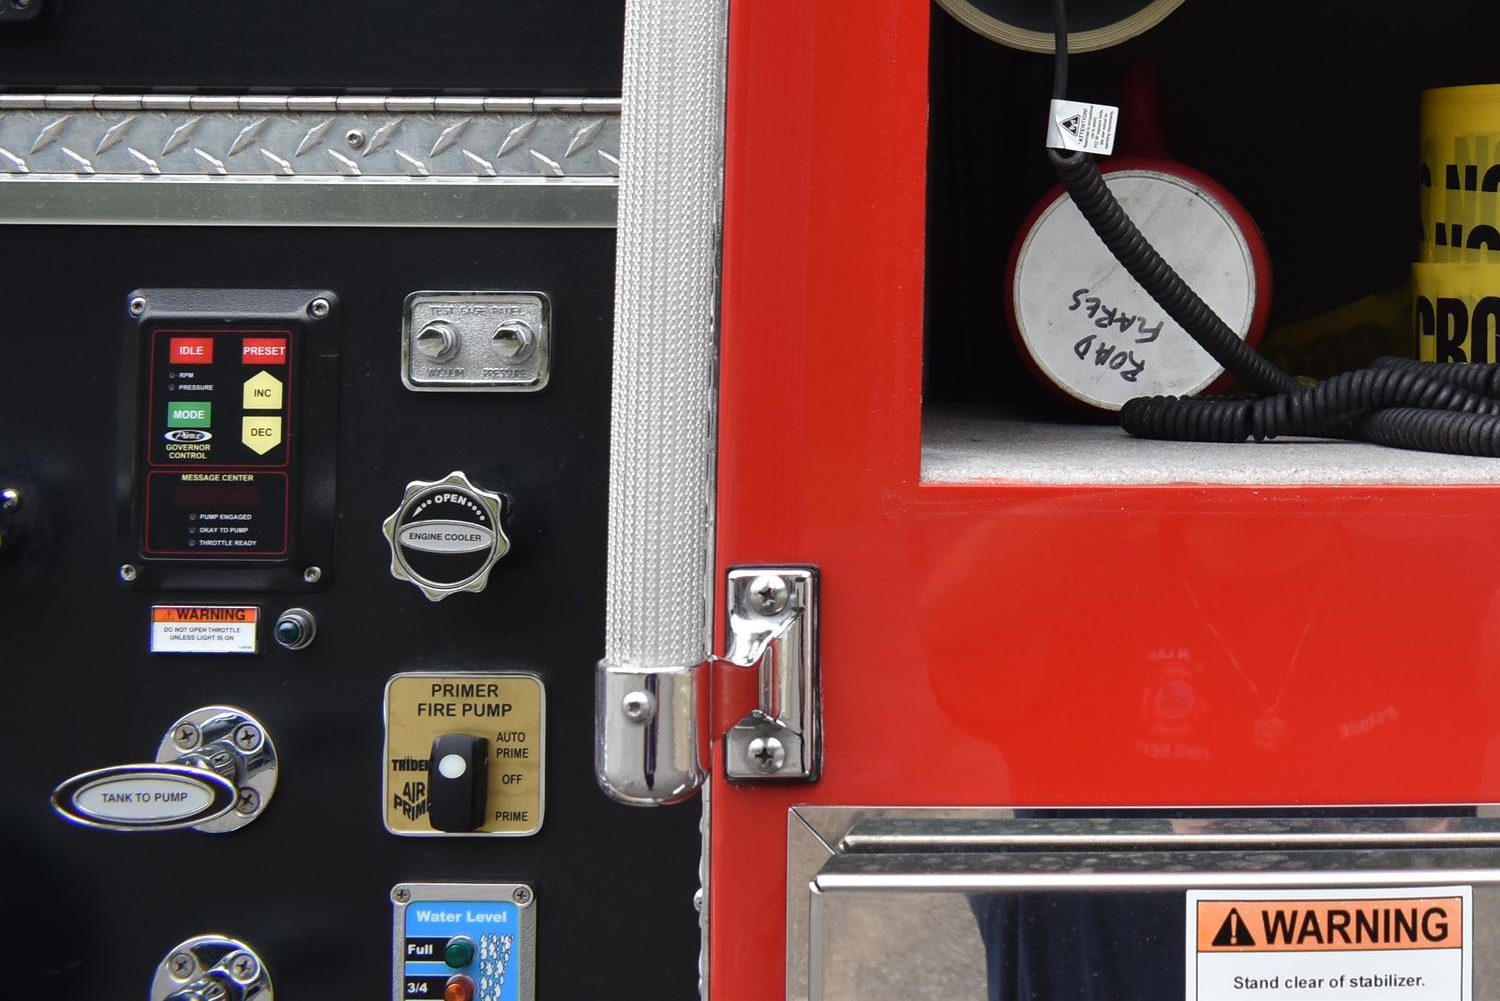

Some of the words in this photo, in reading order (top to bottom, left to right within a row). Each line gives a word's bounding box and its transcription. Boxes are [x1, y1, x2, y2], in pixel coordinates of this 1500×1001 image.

[179, 346, 204, 356] IDLE
[243, 346, 286, 356] PRESET
[1074, 334, 1146, 383] ROAD
[253, 389, 272, 398] INC
[173, 410, 205, 420] MODE
[250, 428, 272, 437] DEC
[434, 493, 467, 506] OPEN
[409, 532, 443, 541] ENGINE
[445, 533, 482, 542] COOLER
[177, 608, 246, 621] WARNING
[431, 683, 499, 697] PRIMER
[417, 703, 457, 717] FIRE
[462, 703, 513, 717] PUMP
[496, 732, 526, 743] AUTO
[496, 748, 529, 759] PRIME
[501, 774, 523, 785] OFF
[102, 793, 132, 803] TANK
[135, 793, 151, 803] TO
[154, 792, 188, 803] PUMP
[403, 781, 426, 804] AIR
[495, 811, 528, 822] PRIME
[416, 910, 462, 923] Water
[466, 910, 507, 923] Level
[1261, 907, 1449, 945] WARNING
[407, 944, 433, 955] Full
[1233, 976, 1279, 990] Stand
[1284, 975, 1325, 989] clear
[1329, 975, 1346, 989] of
[1349, 974, 1426, 988] stabilizer.
[407, 982, 429, 994] 3/4
